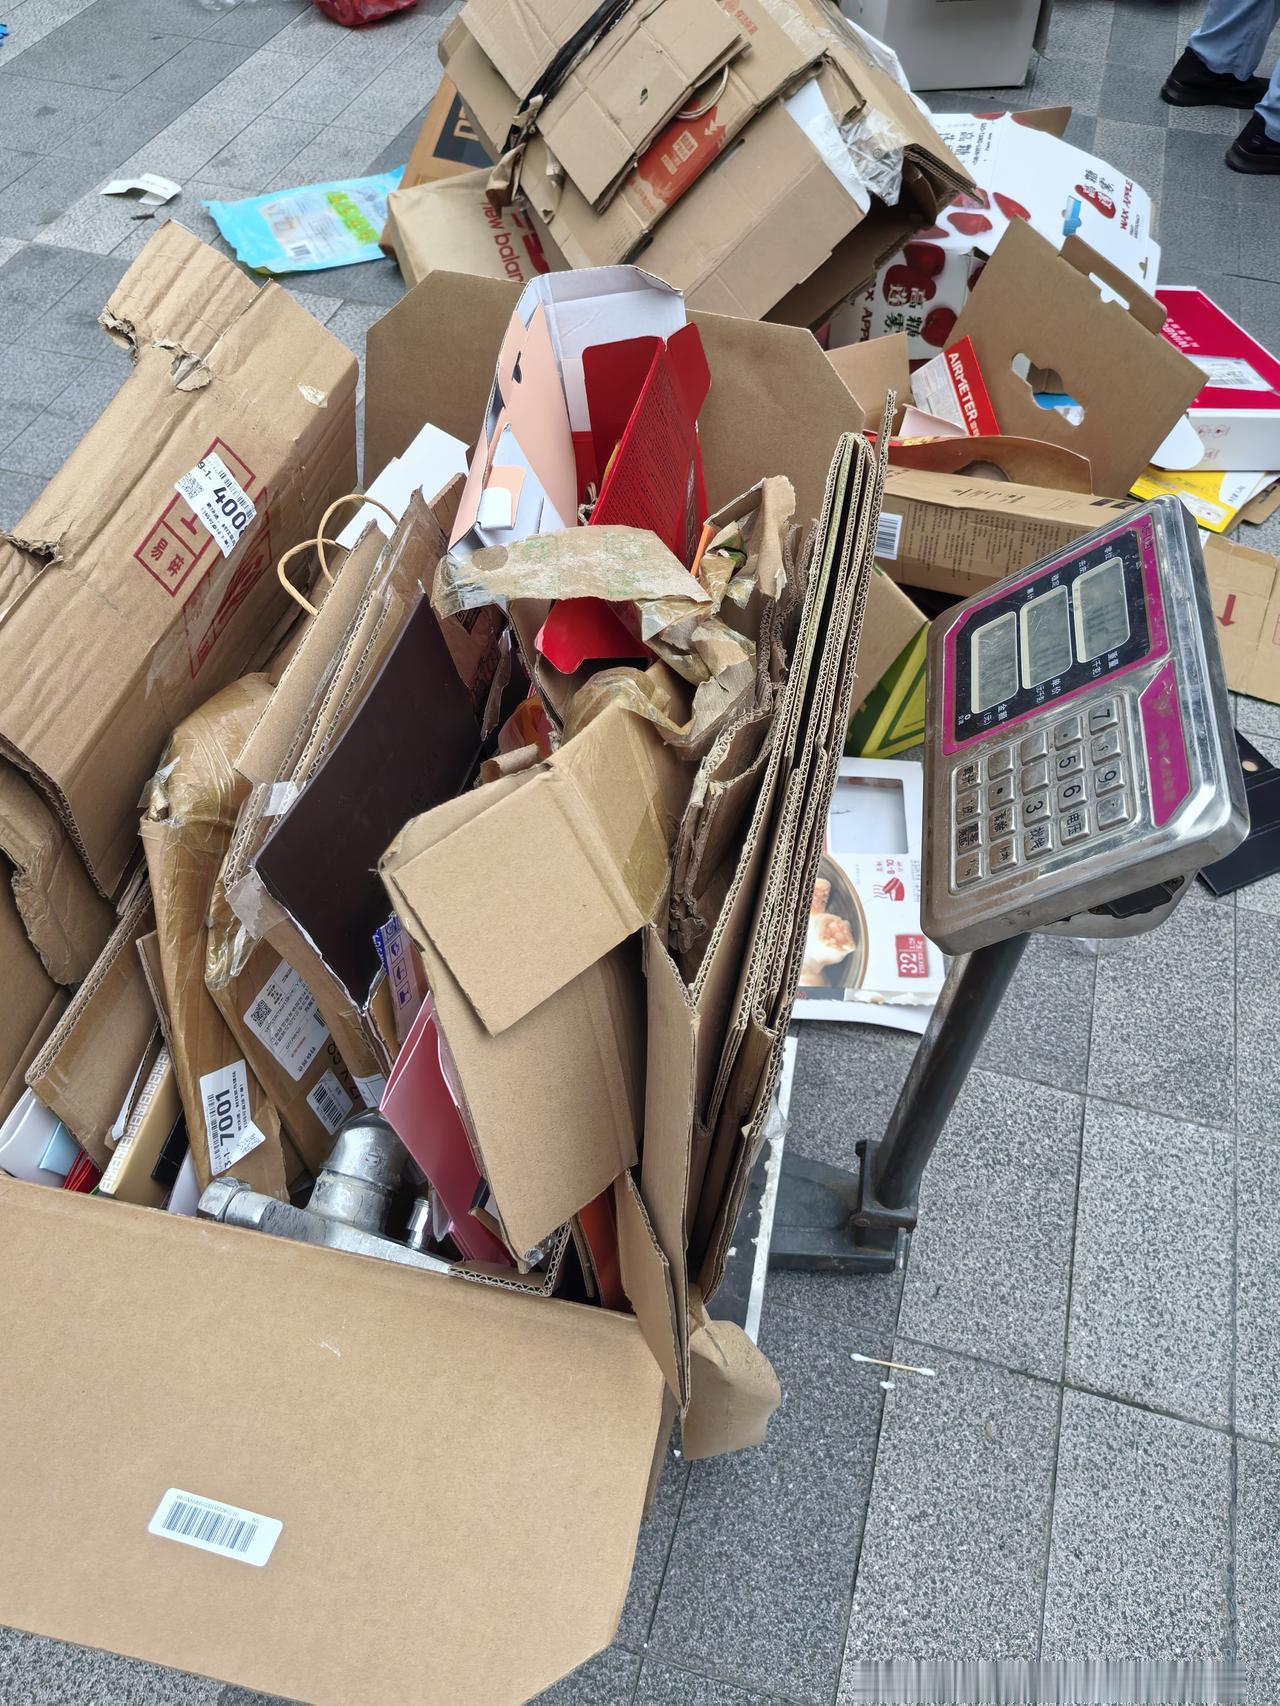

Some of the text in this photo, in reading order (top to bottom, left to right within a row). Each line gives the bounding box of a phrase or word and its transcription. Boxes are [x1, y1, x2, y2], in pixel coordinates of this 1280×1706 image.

[1120, 208, 1129, 231] WAX
[948, 352, 979, 422] AIRMETER
[213, 486, 248, 538] 400
[150, 537, 185, 577] 易碎
[1107, 651, 1119, 669] 重量
[1051, 677, 1062, 696] 单价
[997, 702, 1008, 721] 金额
[1092, 708, 1111, 720] 7
[1059, 755, 1077, 769] 5
[1098, 770, 1117, 784] 9
[1063, 784, 1082, 798] 6
[1025, 800, 1044, 814] 3
[1066, 812, 1082, 837] 电压
[899, 952, 918, 974] 32
[215, 1088, 235, 1147] 7001
